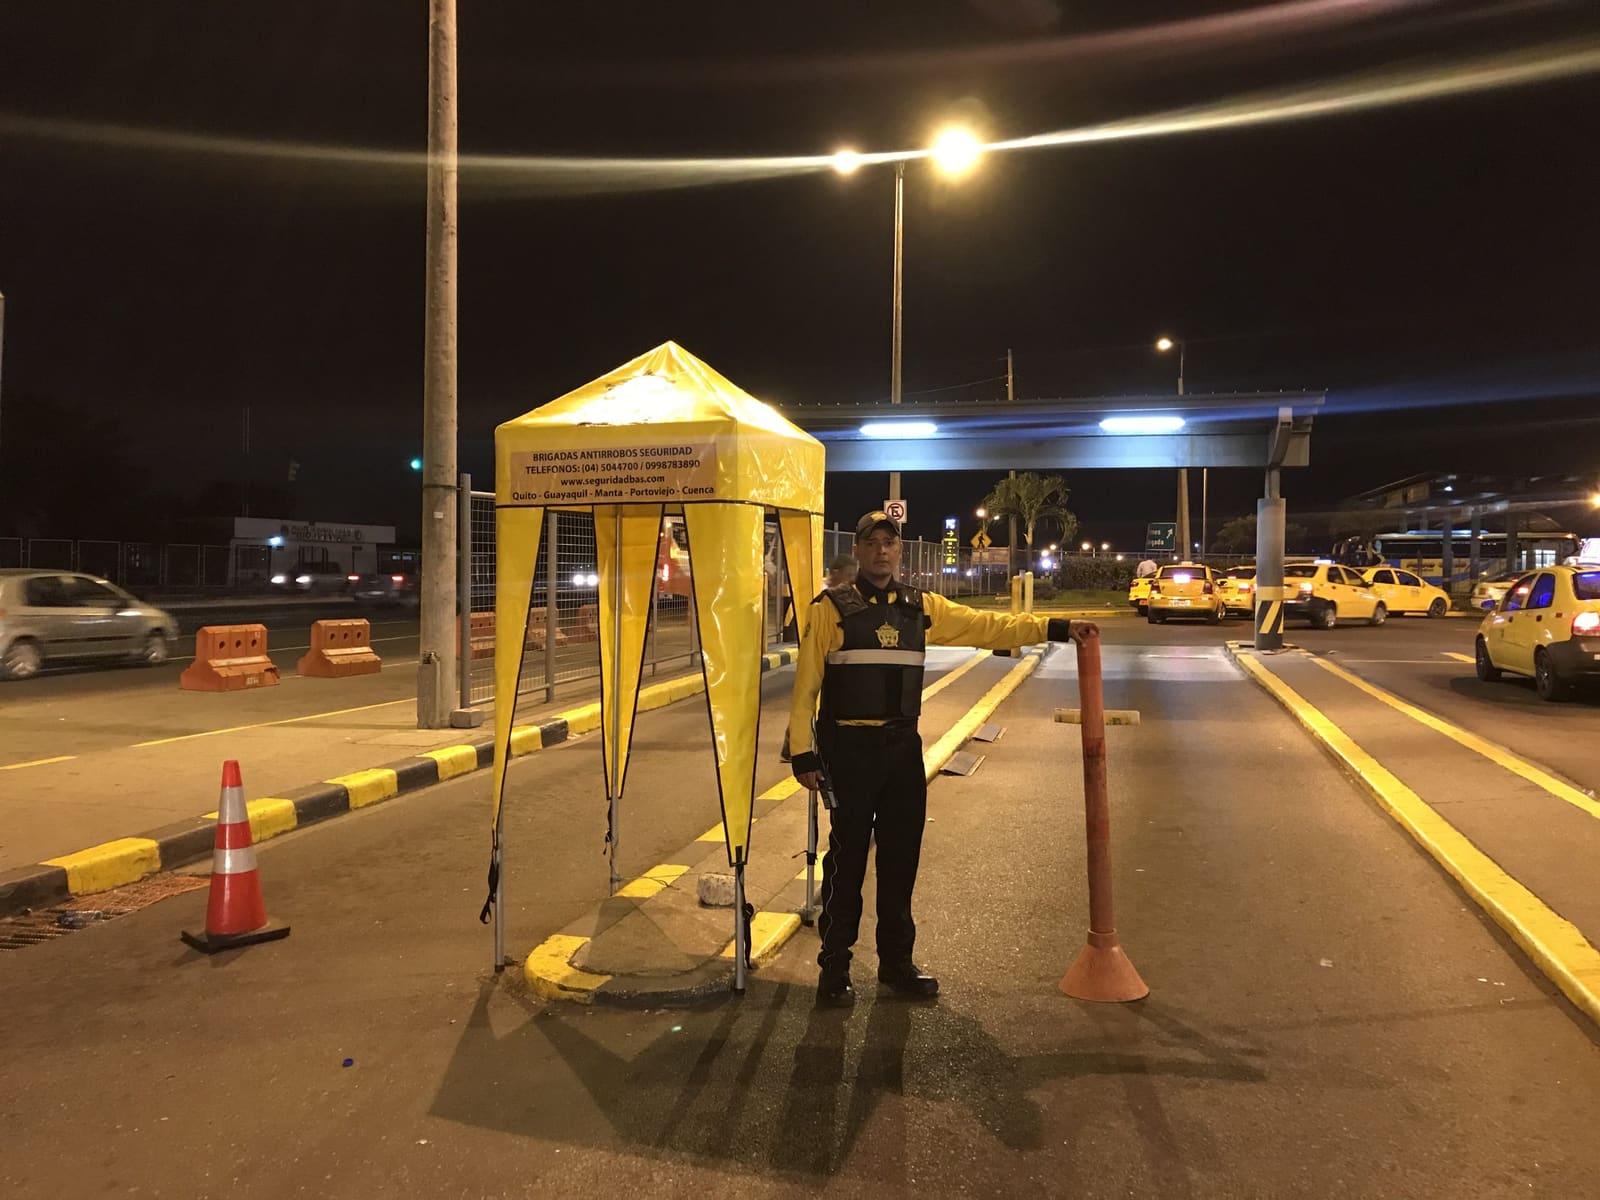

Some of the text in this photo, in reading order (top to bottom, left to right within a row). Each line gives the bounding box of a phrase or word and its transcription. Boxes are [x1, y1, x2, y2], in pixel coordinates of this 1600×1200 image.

[533, 446, 693, 462] BRIGADAS ANTIRROBOS SEGURIDAD
[525, 464, 580, 475] TELEFONOS:
[581, 463, 599, 473] (04)
[600, 462, 639, 473] 5044700
[645, 459, 700, 471] 0998783890
[560, 474, 665, 486] www.seguridadbas.com
[512, 491, 537, 501] Quito
[543, 489, 588, 500] Guayaquil
[594, 488, 623, 498] Manta
[630, 487, 675, 497] Portoviejo
[682, 485, 714, 495] Cuenca
